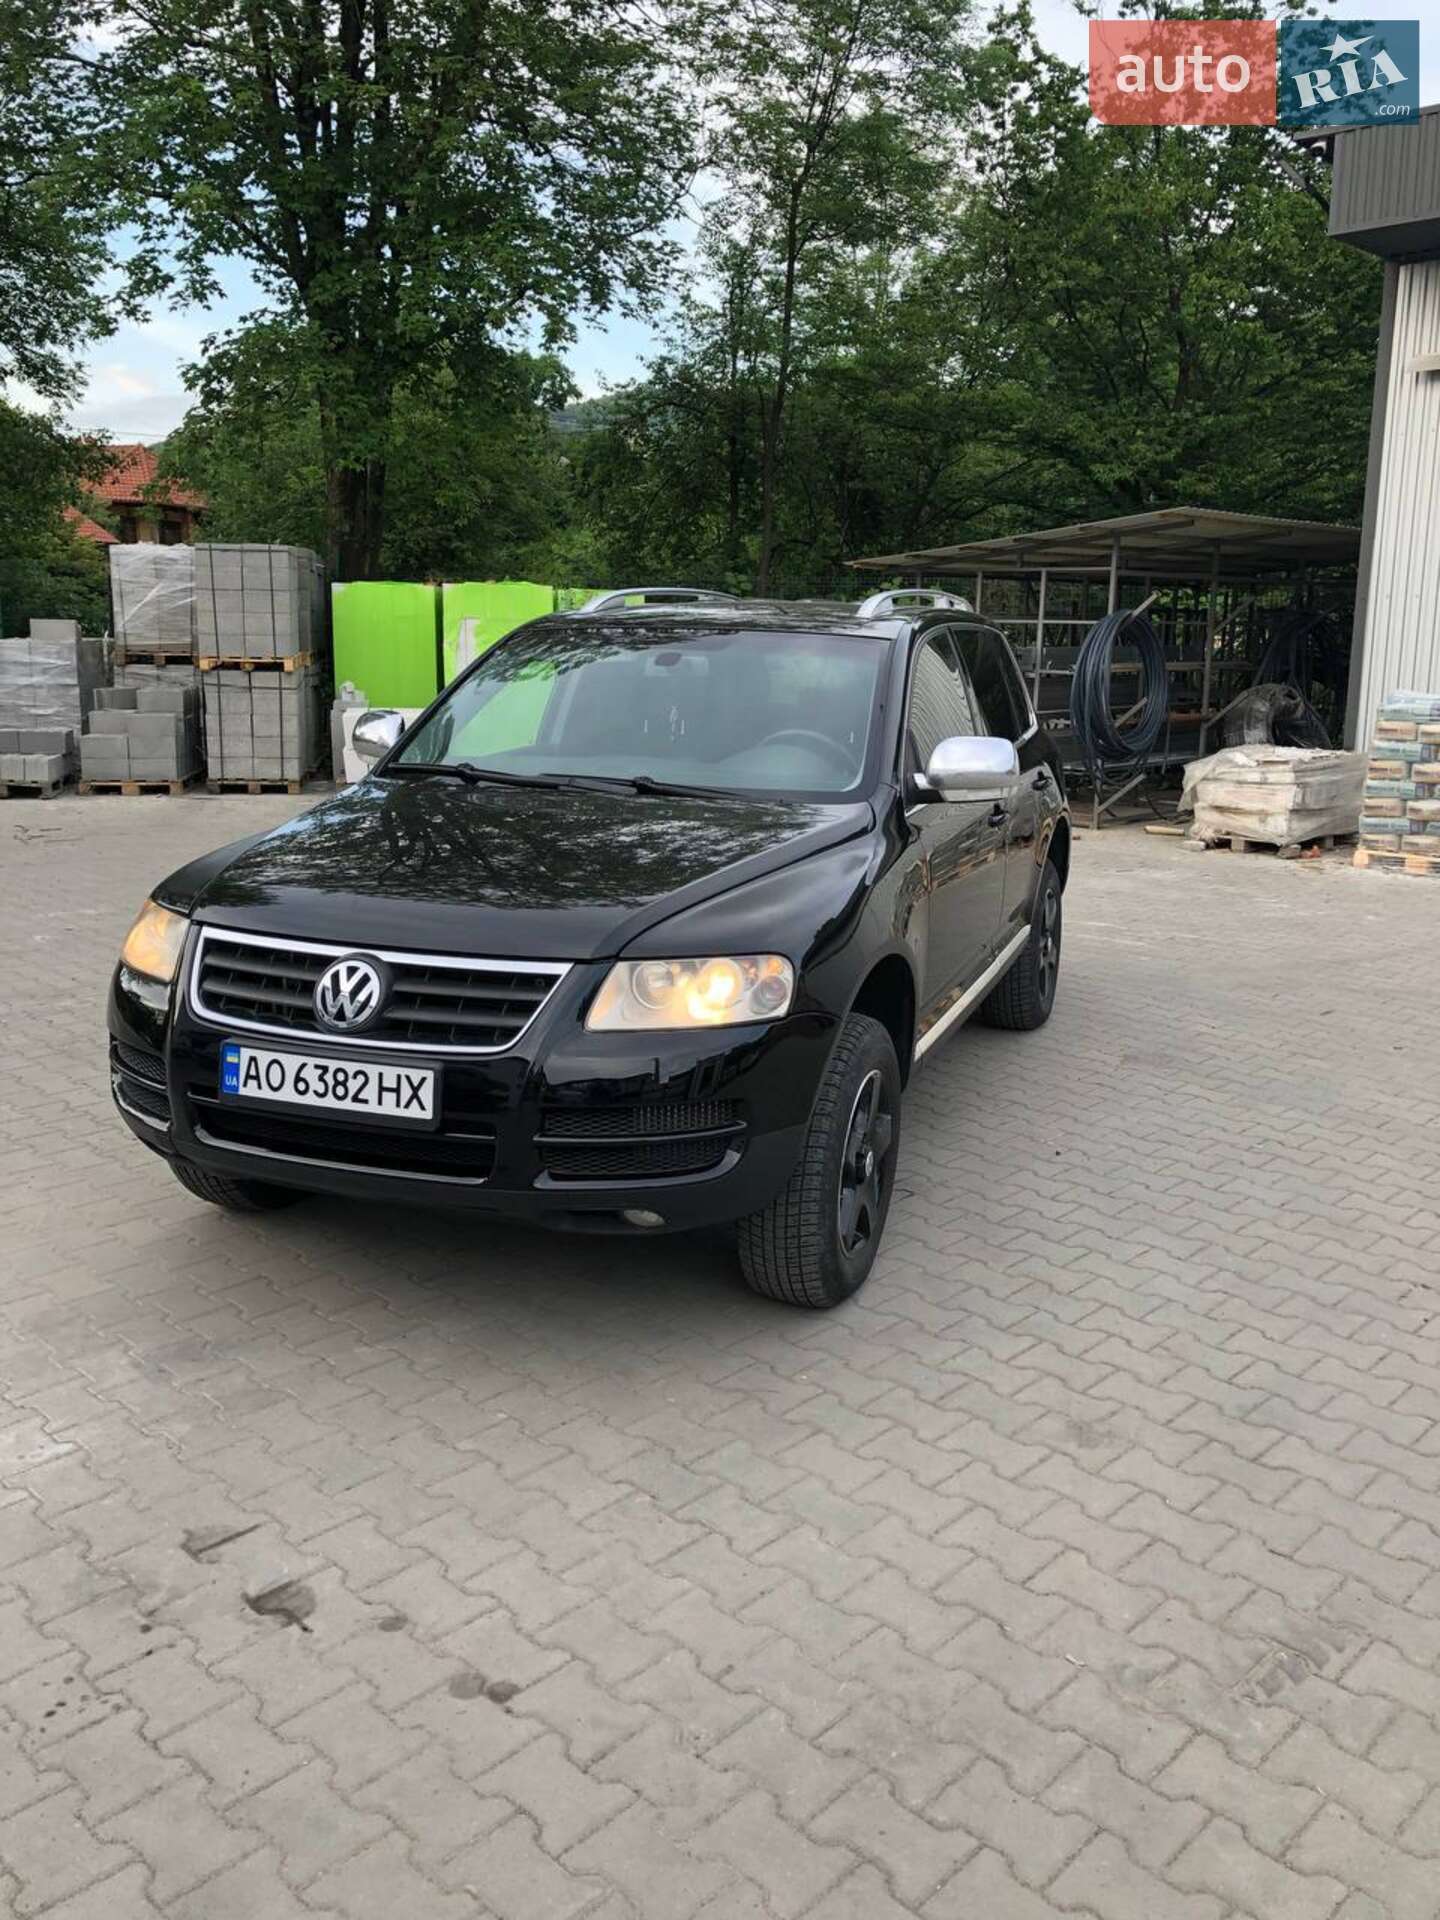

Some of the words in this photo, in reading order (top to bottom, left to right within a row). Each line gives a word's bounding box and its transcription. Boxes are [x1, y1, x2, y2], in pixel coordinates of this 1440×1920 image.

[225, 1075, 239, 1088] UA
[242, 1055, 286, 1092] AO
[293, 1062, 370, 1105] 6382
[377, 1071, 428, 1111] HX
